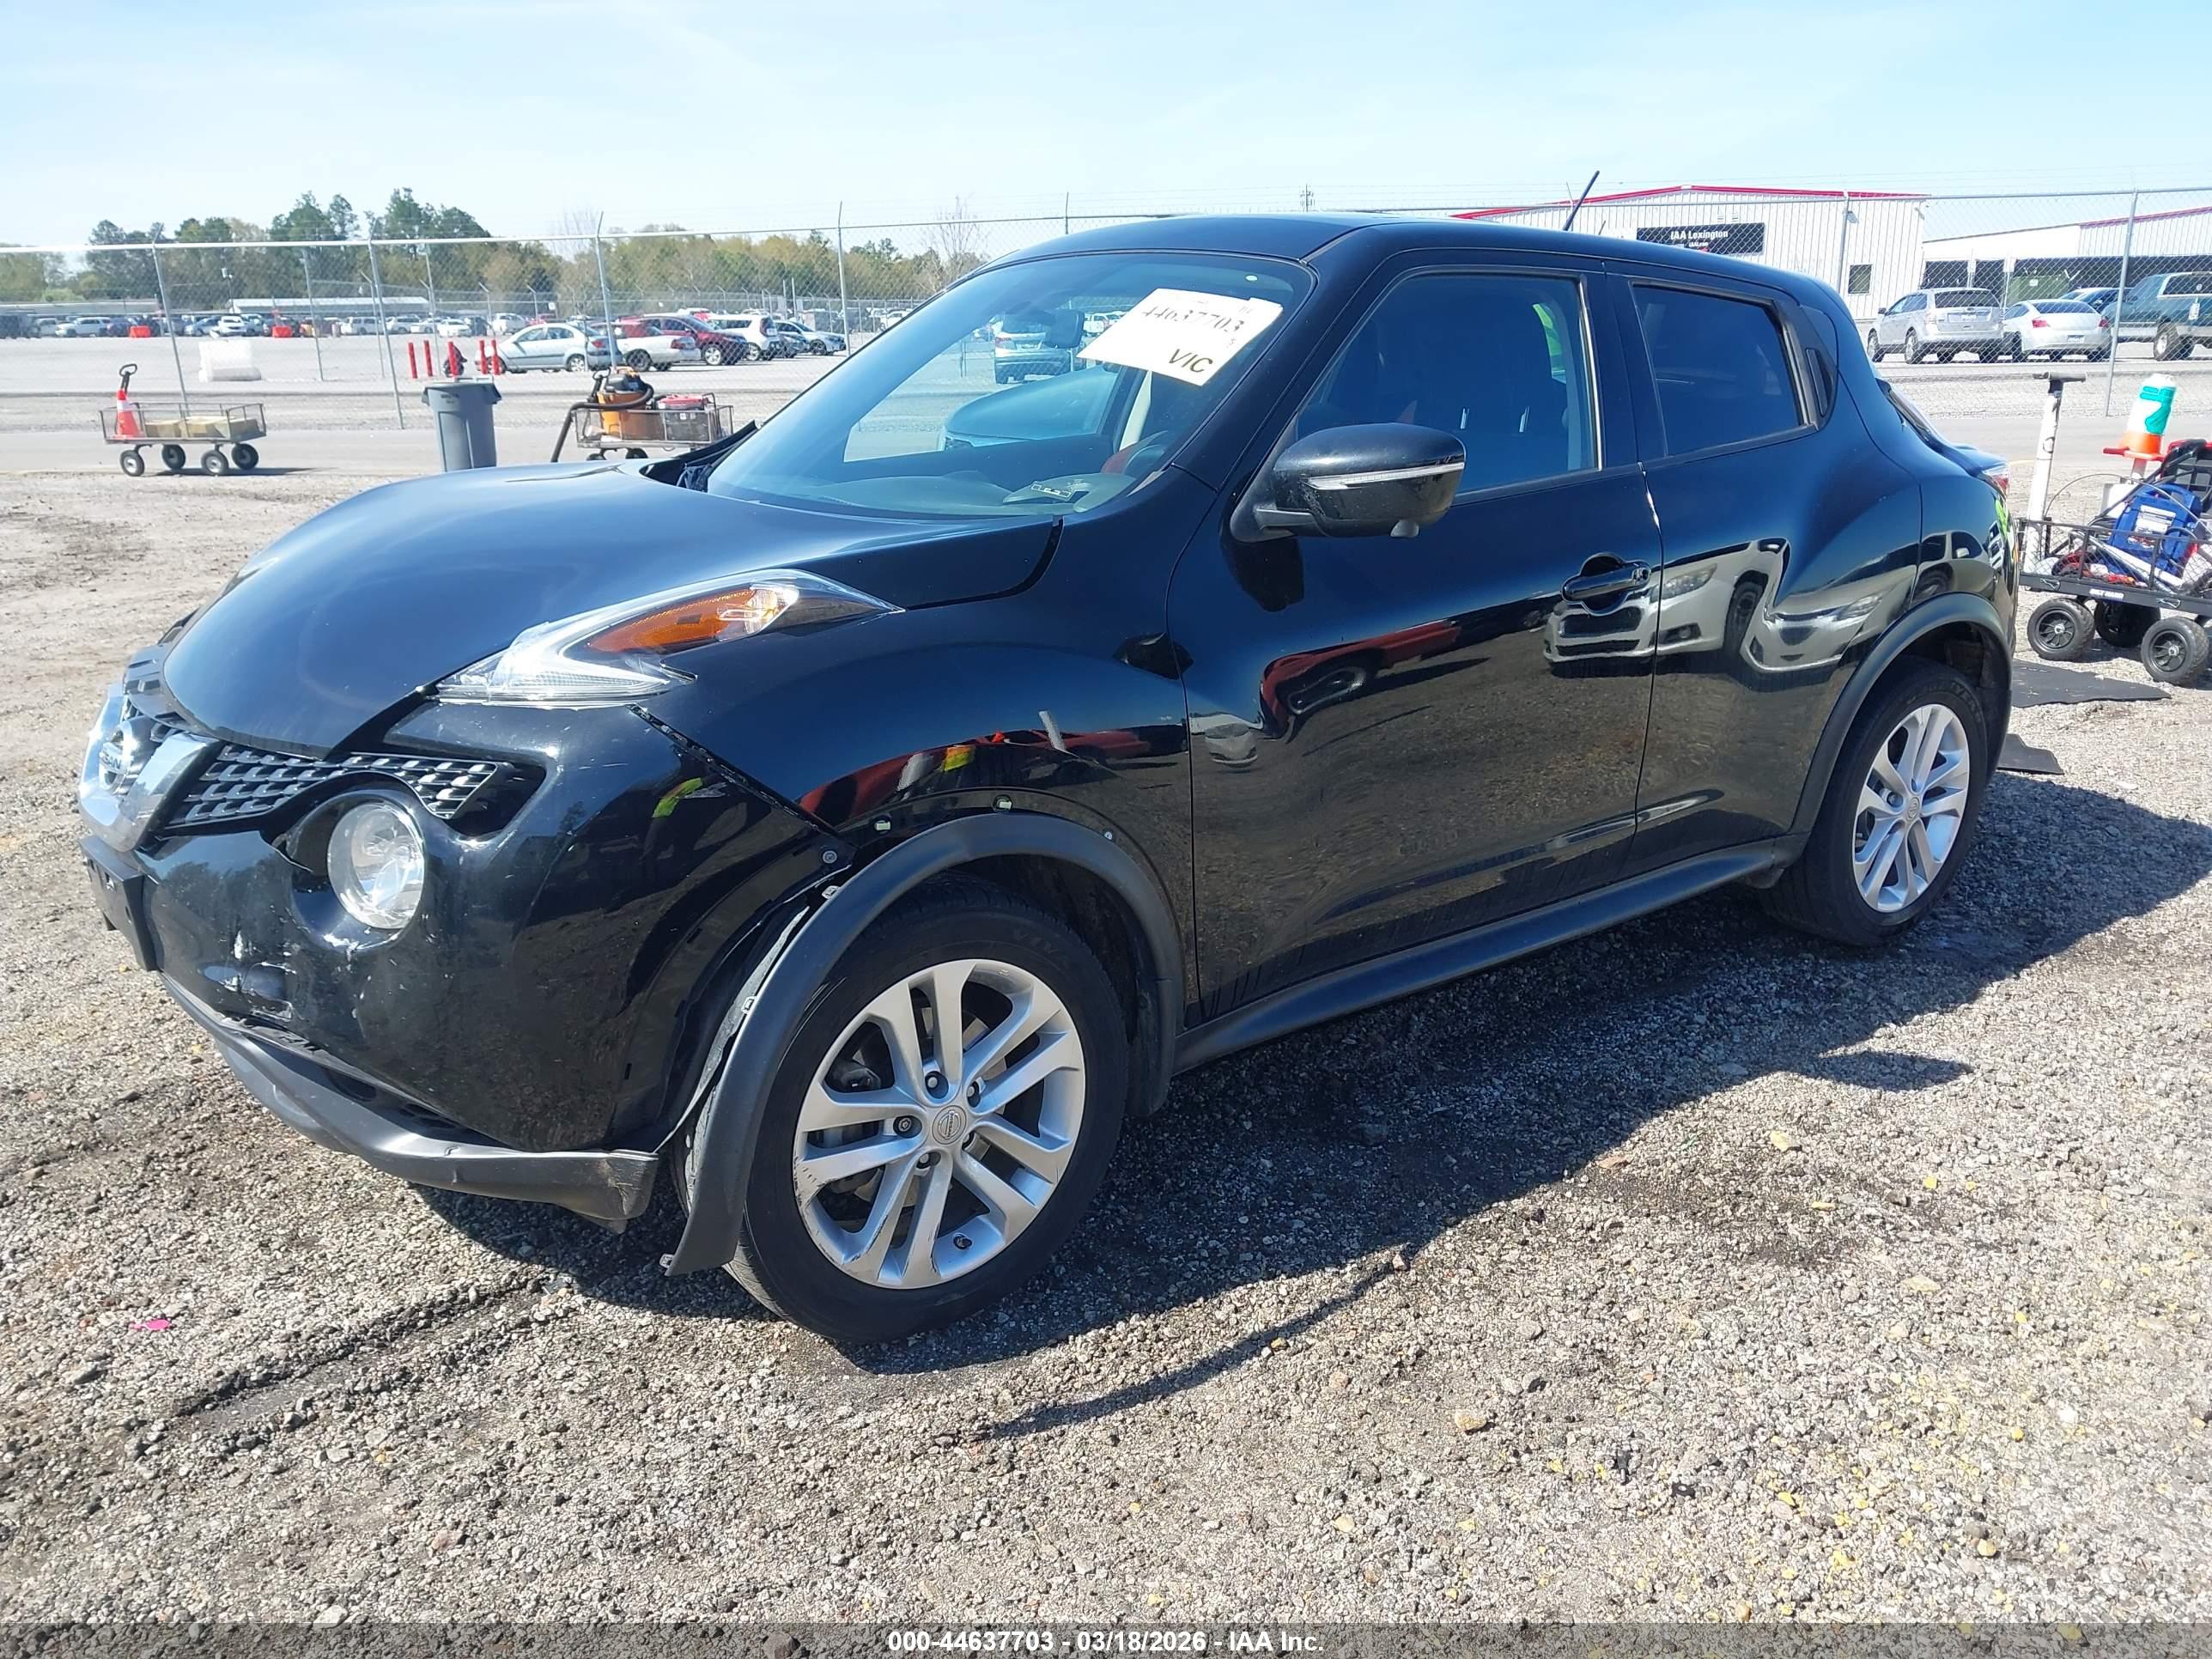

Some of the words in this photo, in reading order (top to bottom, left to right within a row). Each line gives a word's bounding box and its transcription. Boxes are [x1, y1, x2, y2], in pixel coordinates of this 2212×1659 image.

[1671, 230, 1686, 240] IAA
[1688, 229, 1729, 240] Lexington
[1142, 306, 1245, 333] 44637703
[1169, 349, 1213, 373] VIC
